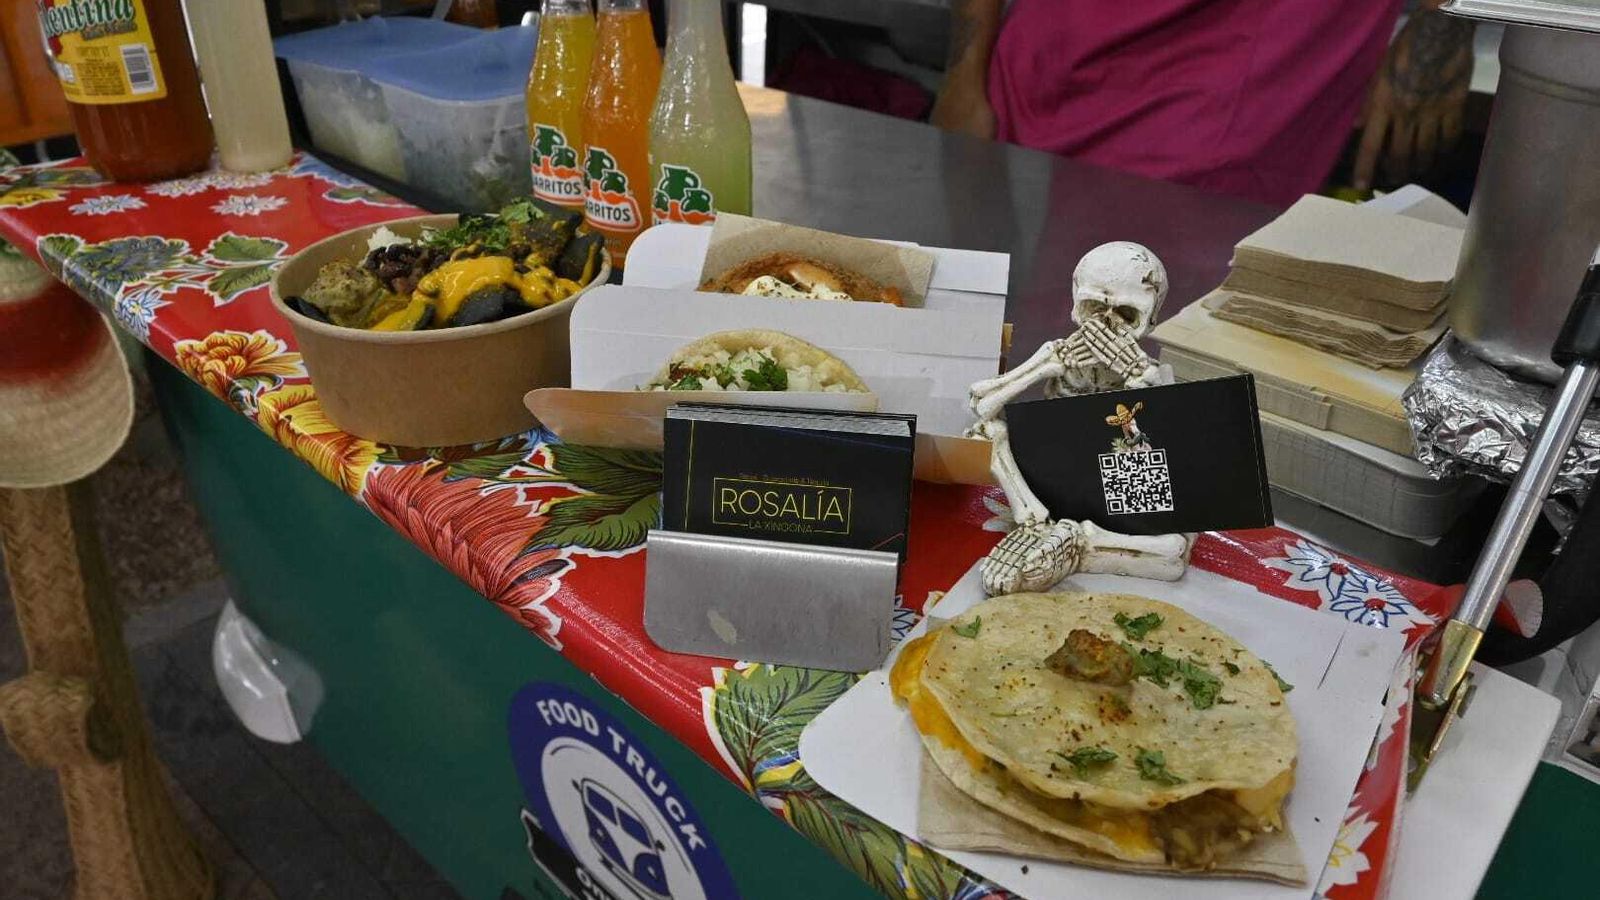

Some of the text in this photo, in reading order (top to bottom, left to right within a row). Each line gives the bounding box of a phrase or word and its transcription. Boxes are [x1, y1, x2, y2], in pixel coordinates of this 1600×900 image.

[721, 488, 844, 523] ROSALÍA
[536, 699, 707, 851] FOOD TRUCK
